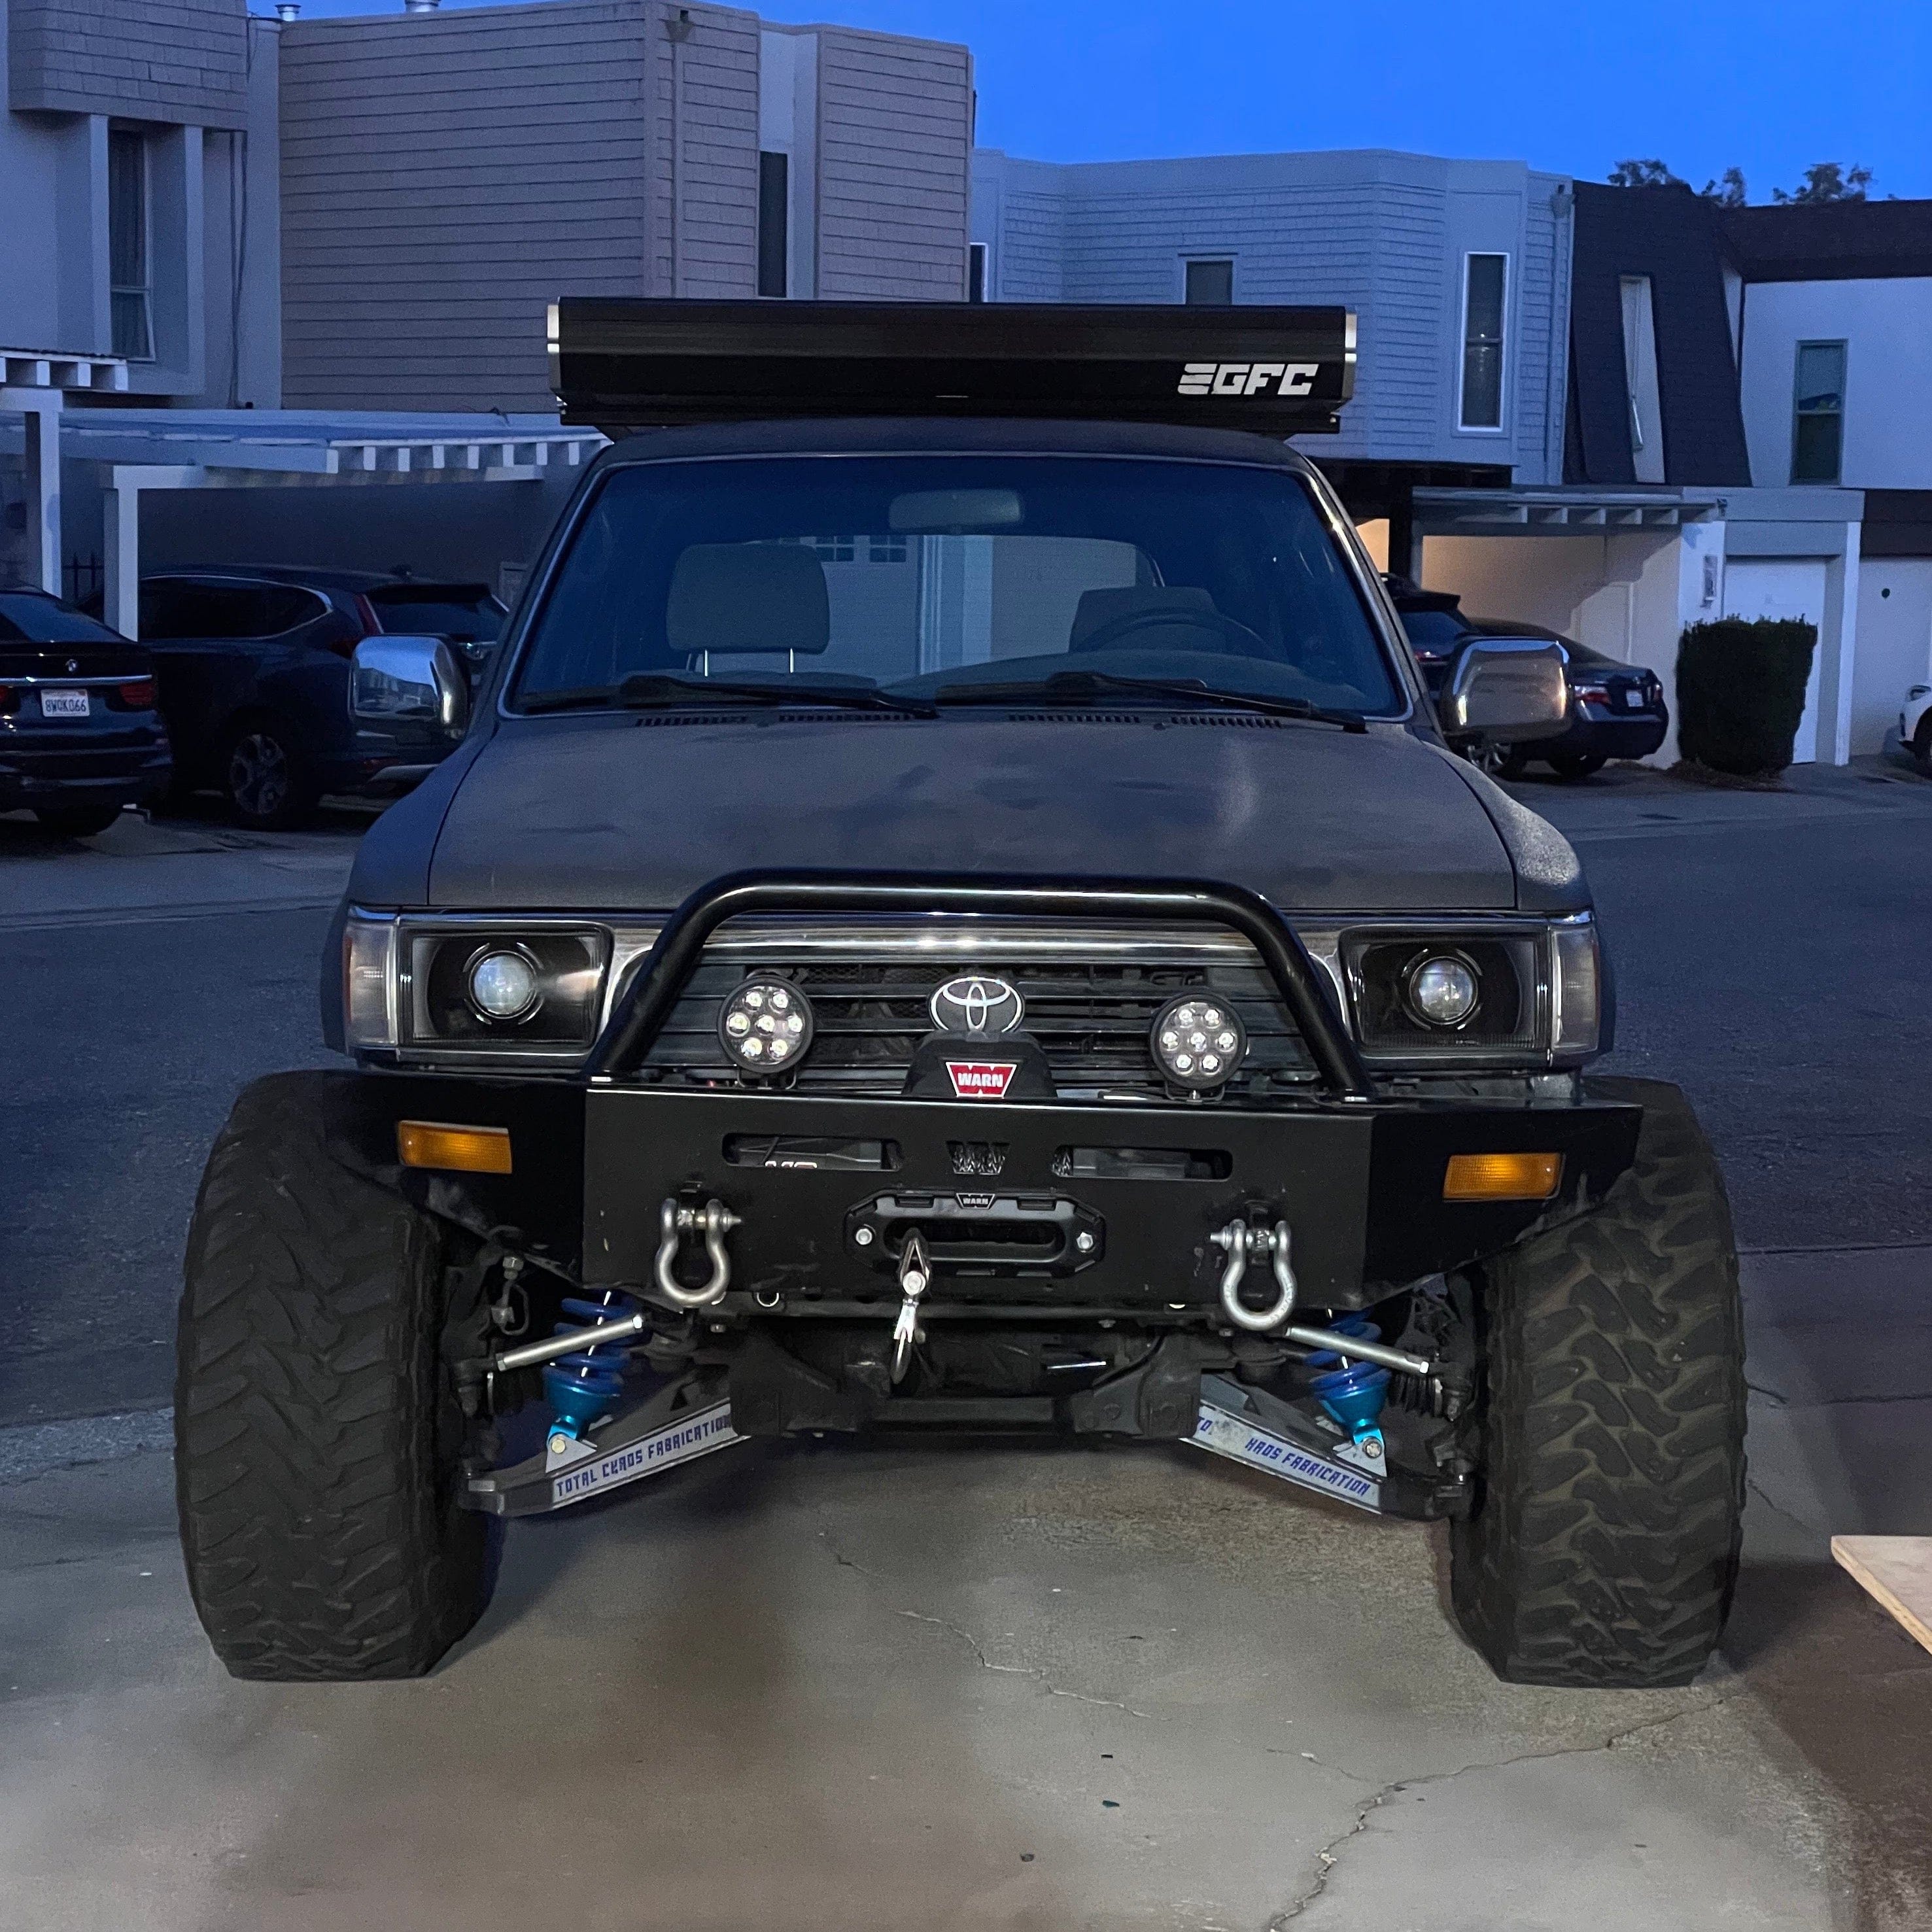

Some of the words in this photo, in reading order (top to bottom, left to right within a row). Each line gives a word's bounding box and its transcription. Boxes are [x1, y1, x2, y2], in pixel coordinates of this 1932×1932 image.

[957, 1072, 1004, 1087] WARN
[557, 1470, 597, 1496] TOTAL
[602, 1450, 643, 1477] CHAOS
[1245, 1438, 1283, 1460] HAOS
[1282, 1453, 1371, 1496] FABRICATION
